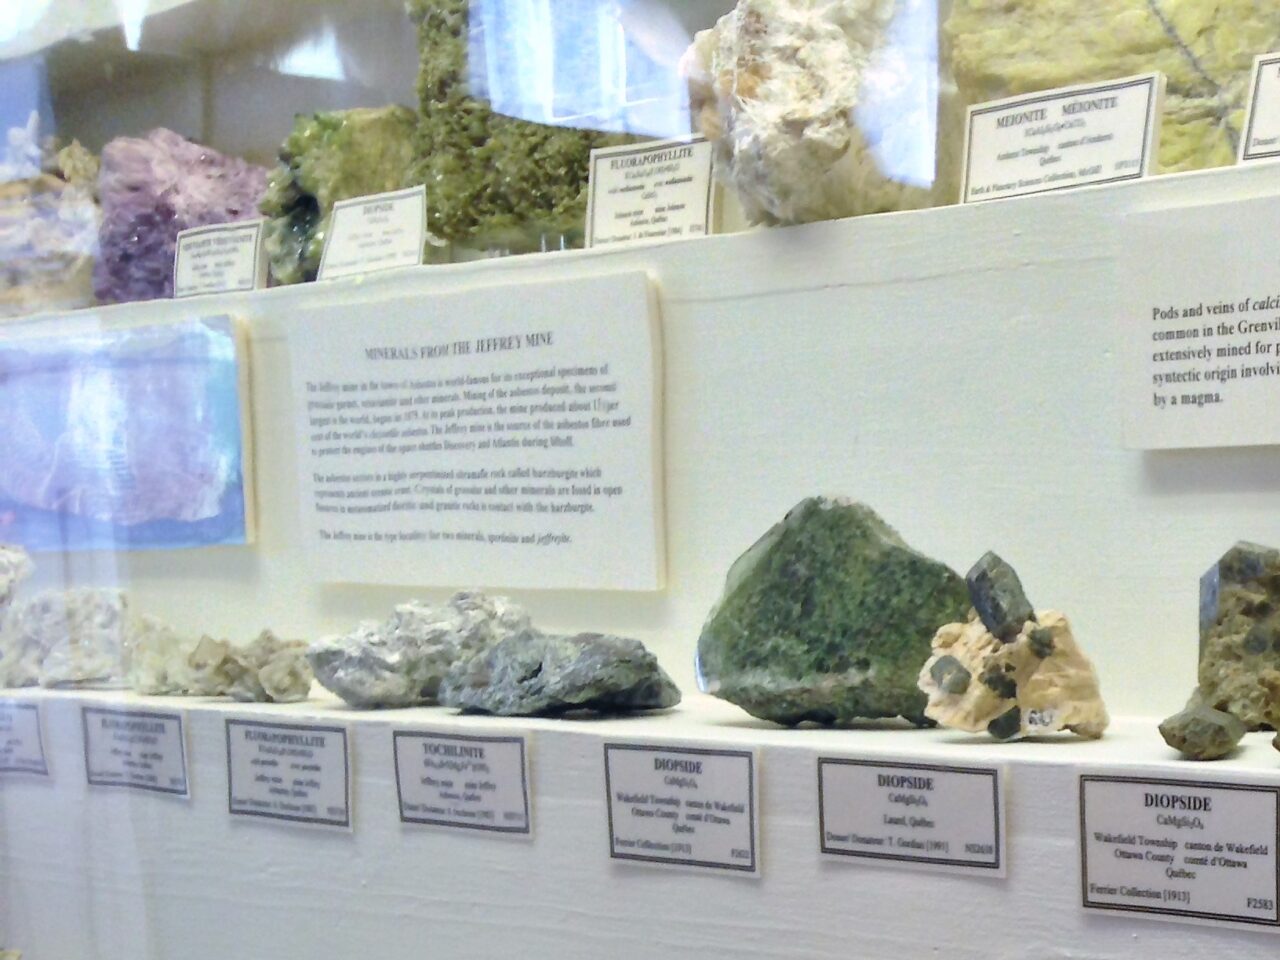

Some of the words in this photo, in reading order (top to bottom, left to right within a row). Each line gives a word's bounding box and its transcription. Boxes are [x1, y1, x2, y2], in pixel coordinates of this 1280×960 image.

[1152, 307, 1179, 320] Pods
[1183, 304, 1203, 317] and
[1206, 302, 1234, 315] veins
[1239, 299, 1250, 311] of
[452, 341, 471, 356] THE
[525, 331, 554, 347] MINE
[1152, 346, 1212, 362] extensively
[1216, 343, 1251, 357] mined
[1255, 341, 1272, 354] for
[1152, 367, 1200, 384] syntectic
[1204, 364, 1237, 382] origin
[654, 758, 703, 775] DIOPSIDE
[877, 774, 934, 791] DIOPSIDE
[1144, 793, 1212, 812] DIOPSIDE
[1247, 897, 1273, 910] F2583
